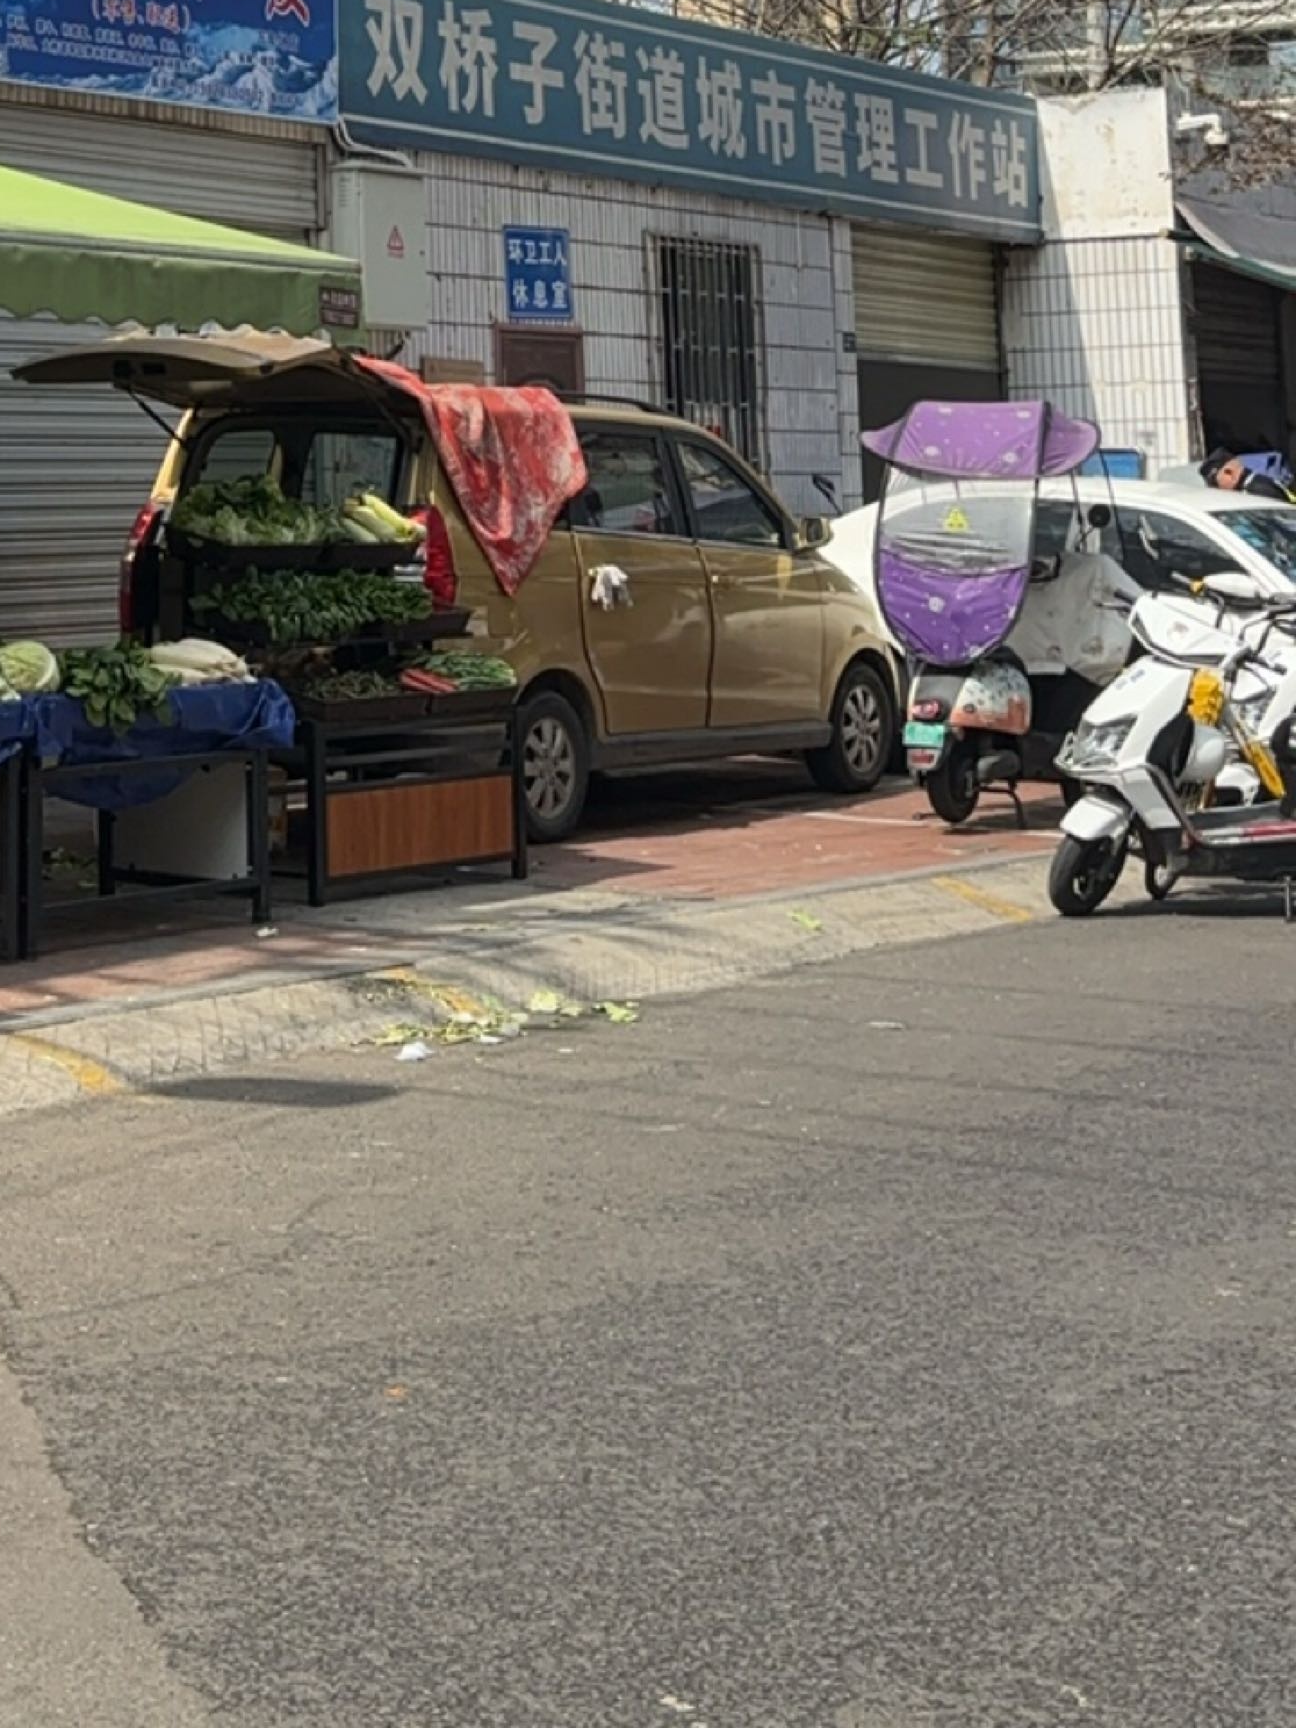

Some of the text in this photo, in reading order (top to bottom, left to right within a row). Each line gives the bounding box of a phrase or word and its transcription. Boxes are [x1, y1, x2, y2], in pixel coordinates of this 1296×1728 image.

[507, 238, 567, 266] 环卫工人
[512, 278, 568, 309] 休息室
